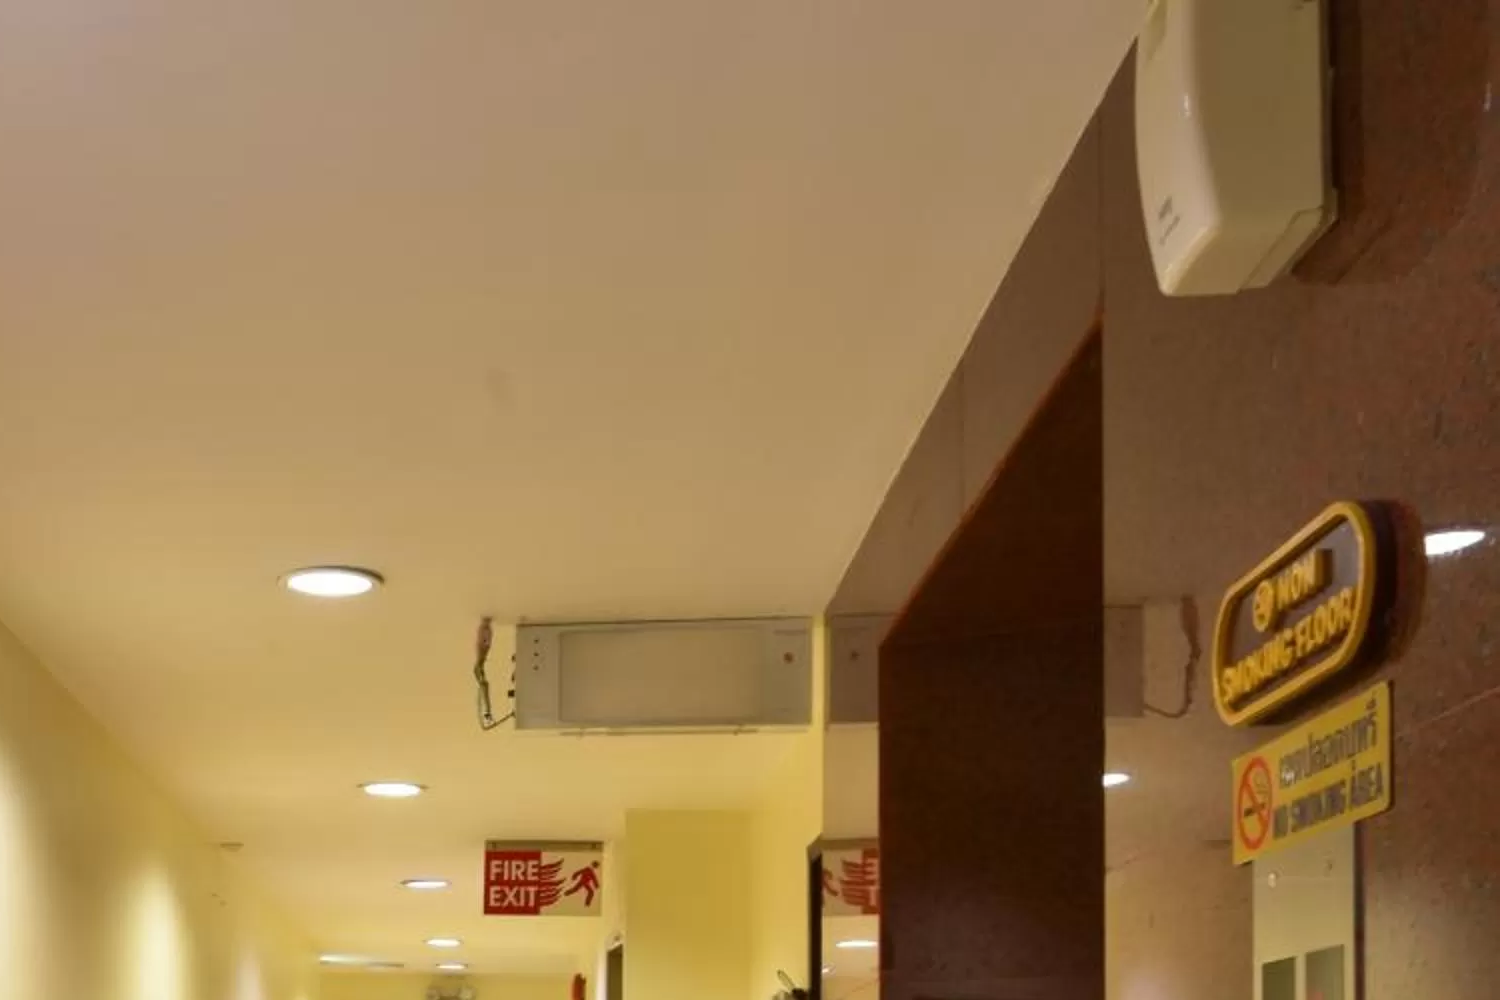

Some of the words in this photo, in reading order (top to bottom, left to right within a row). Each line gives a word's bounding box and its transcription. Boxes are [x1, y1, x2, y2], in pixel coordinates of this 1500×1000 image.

[1221, 627, 1295, 704] SMOKING
[1294, 585, 1353, 658] FLOOR
[490, 859, 540, 881] FIRE
[489, 885, 539, 907] EXIT
